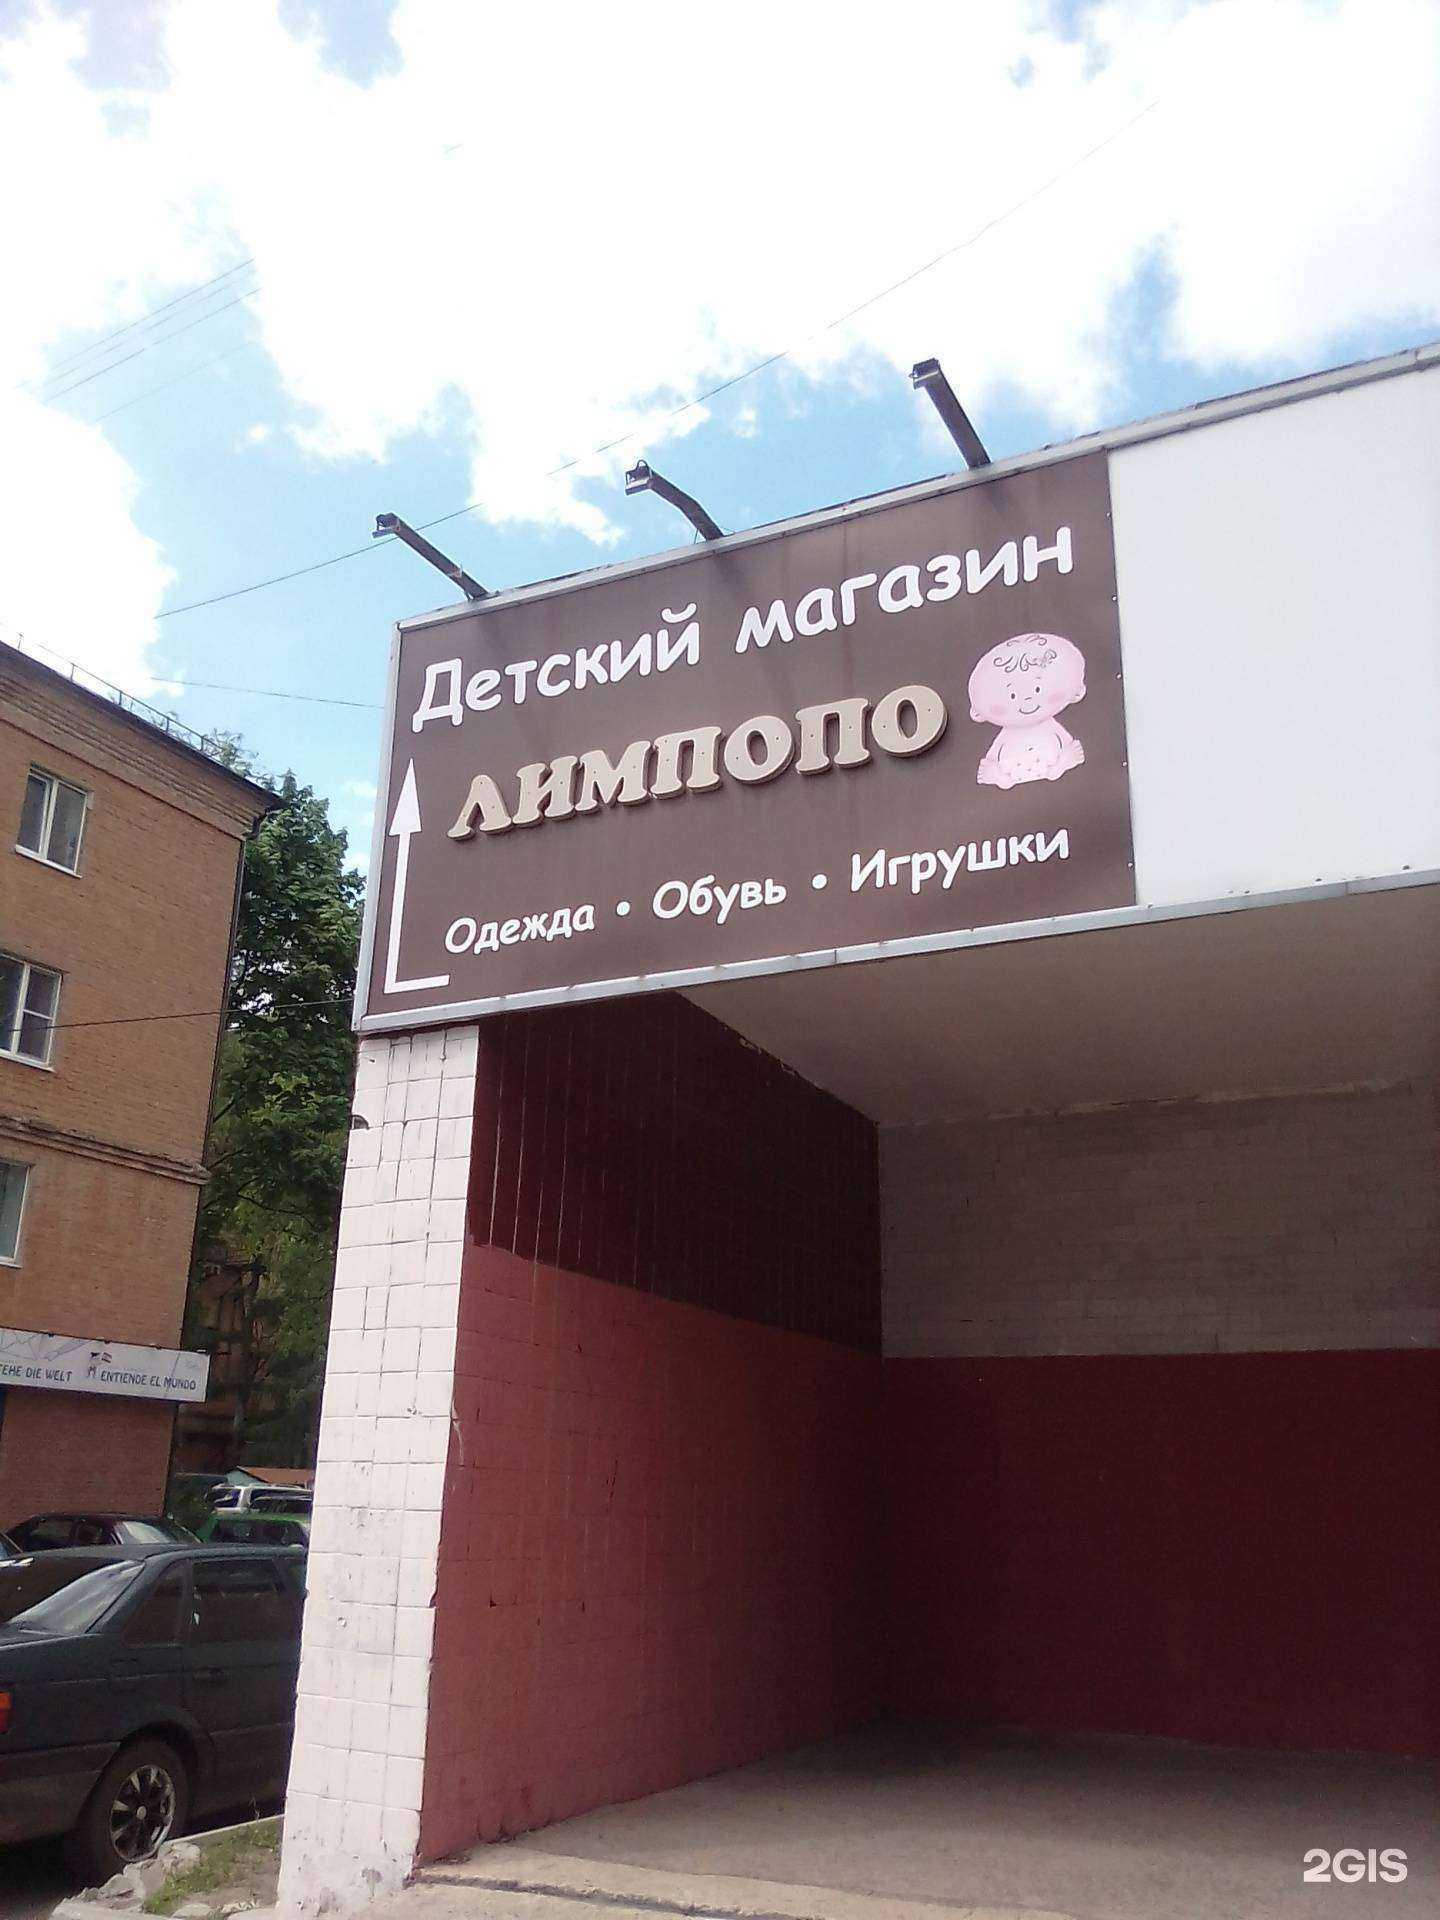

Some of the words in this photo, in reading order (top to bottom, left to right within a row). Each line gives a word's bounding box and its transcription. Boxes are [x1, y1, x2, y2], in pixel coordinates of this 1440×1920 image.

[411, 602, 701, 733] Детский
[734, 525, 1074, 655] магазин
[444, 903, 596, 955] Одежда
[651, 876, 787, 925] Обувь
[849, 827, 1072, 894] Игрушки
[0, 1363, 22, 1377] EHE
[25, 1366, 42, 1379] DIE
[45, 1368, 73, 1381] WELT
[100, 1370, 147, 1386] ENTIENDE
[149, 1375, 162, 1387] EL
[163, 1377, 197, 1391] MUNDO
